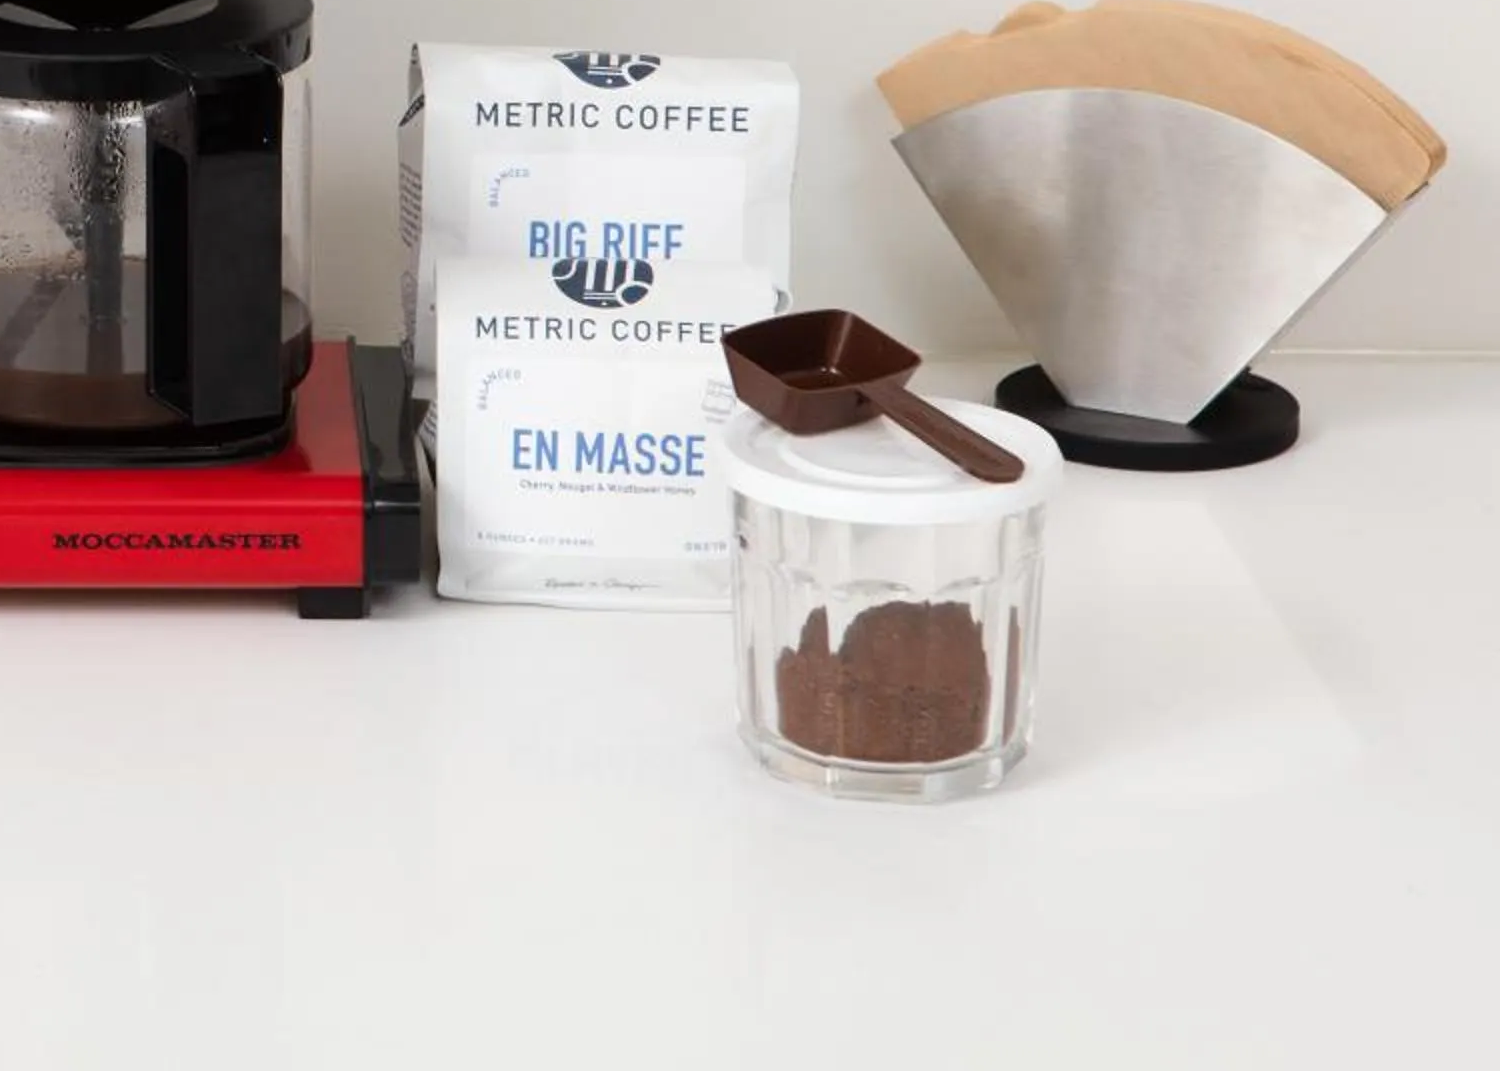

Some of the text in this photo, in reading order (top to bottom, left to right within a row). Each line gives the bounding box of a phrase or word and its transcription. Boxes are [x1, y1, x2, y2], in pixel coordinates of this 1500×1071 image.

[476, 102, 750, 133] METRIC COFFEE
[529, 219, 684, 260] BIG RIFF
[476, 315, 597, 341] METRIC
[512, 428, 706, 477] EN MASSE
[52, 532, 302, 550] MOCCAMASTER
